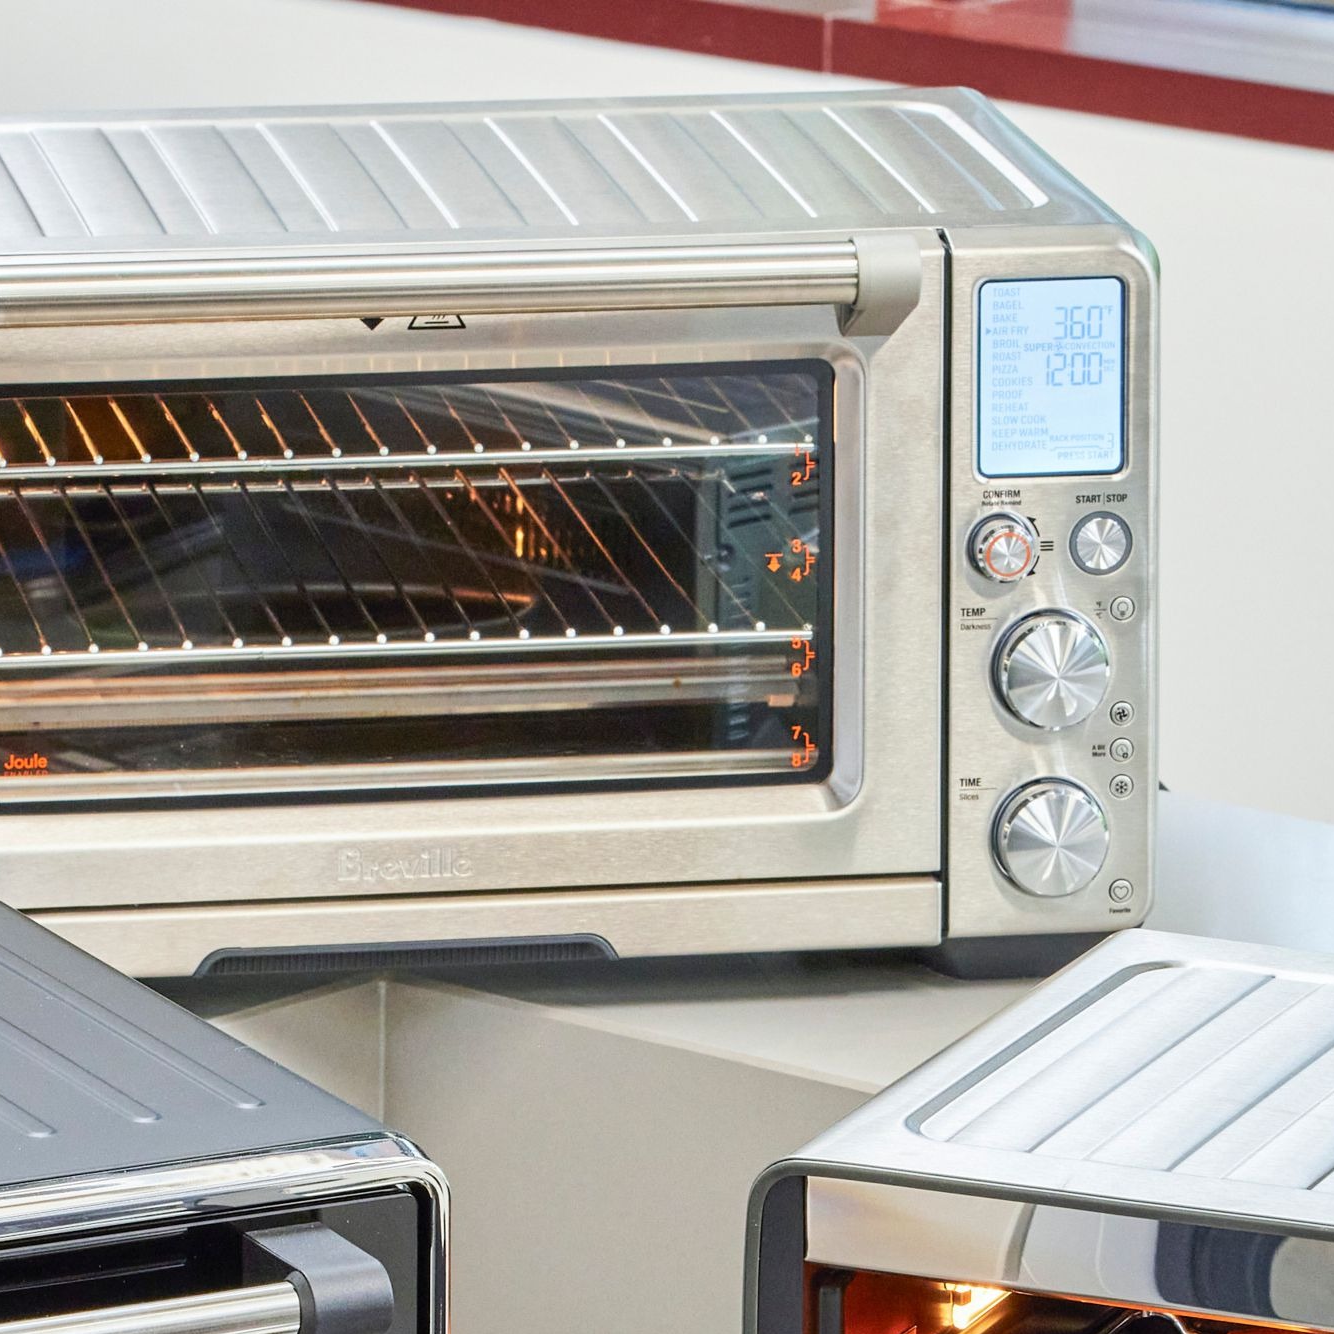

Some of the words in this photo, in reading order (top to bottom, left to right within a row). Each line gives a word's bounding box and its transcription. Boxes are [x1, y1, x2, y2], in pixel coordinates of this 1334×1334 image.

[993, 287, 1021, 297] TOAST
[992, 301, 1024, 310] BAGEL
[992, 313, 1018, 323] BAKE
[1054, 305, 1103, 339] 360
[992, 327, 1008, 336] AIR
[1011, 326, 1029, 336] FRY
[992, 339, 1020, 349] BROIL
[1023, 342, 1052, 352] SUPER
[1065, 341, 1115, 351] CONVECTION
[992, 351, 1021, 361] ROAST
[992, 364, 1018, 374] PIZZA
[1046, 352, 1103, 386] 12:00
[992, 377, 1033, 387] COOKIES
[992, 390, 1023, 400] PROOF
[991, 402, 1028, 412] REHEAT
[991, 416, 1018, 426] SLOW
[1021, 415, 1047, 424] COOK
[991, 428, 1017, 438] KEEP
[1019, 427, 1049, 437] WARM
[991, 440, 1048, 451] DEHYDRATE
[1057, 451, 1085, 460] PRESS
[1087, 450, 1114, 459] START
[792, 471, 802, 485] 2
[983, 490, 1020, 499] CONFIRM
[1076, 495, 1101, 504] START
[1106, 493, 1128, 503] STOP
[792, 538, 802, 553] 3
[791, 567, 802, 582] 4
[960, 608, 986, 617] TEMP
[960, 623, 992, 631] Darkness
[792, 662, 802, 677] 6
[792, 725, 802, 740] 7
[4, 753, 48, 770] Joule
[792, 753, 802, 767] 8
[959, 778, 981, 787] TIME
[337, 848, 474, 881] Breville
